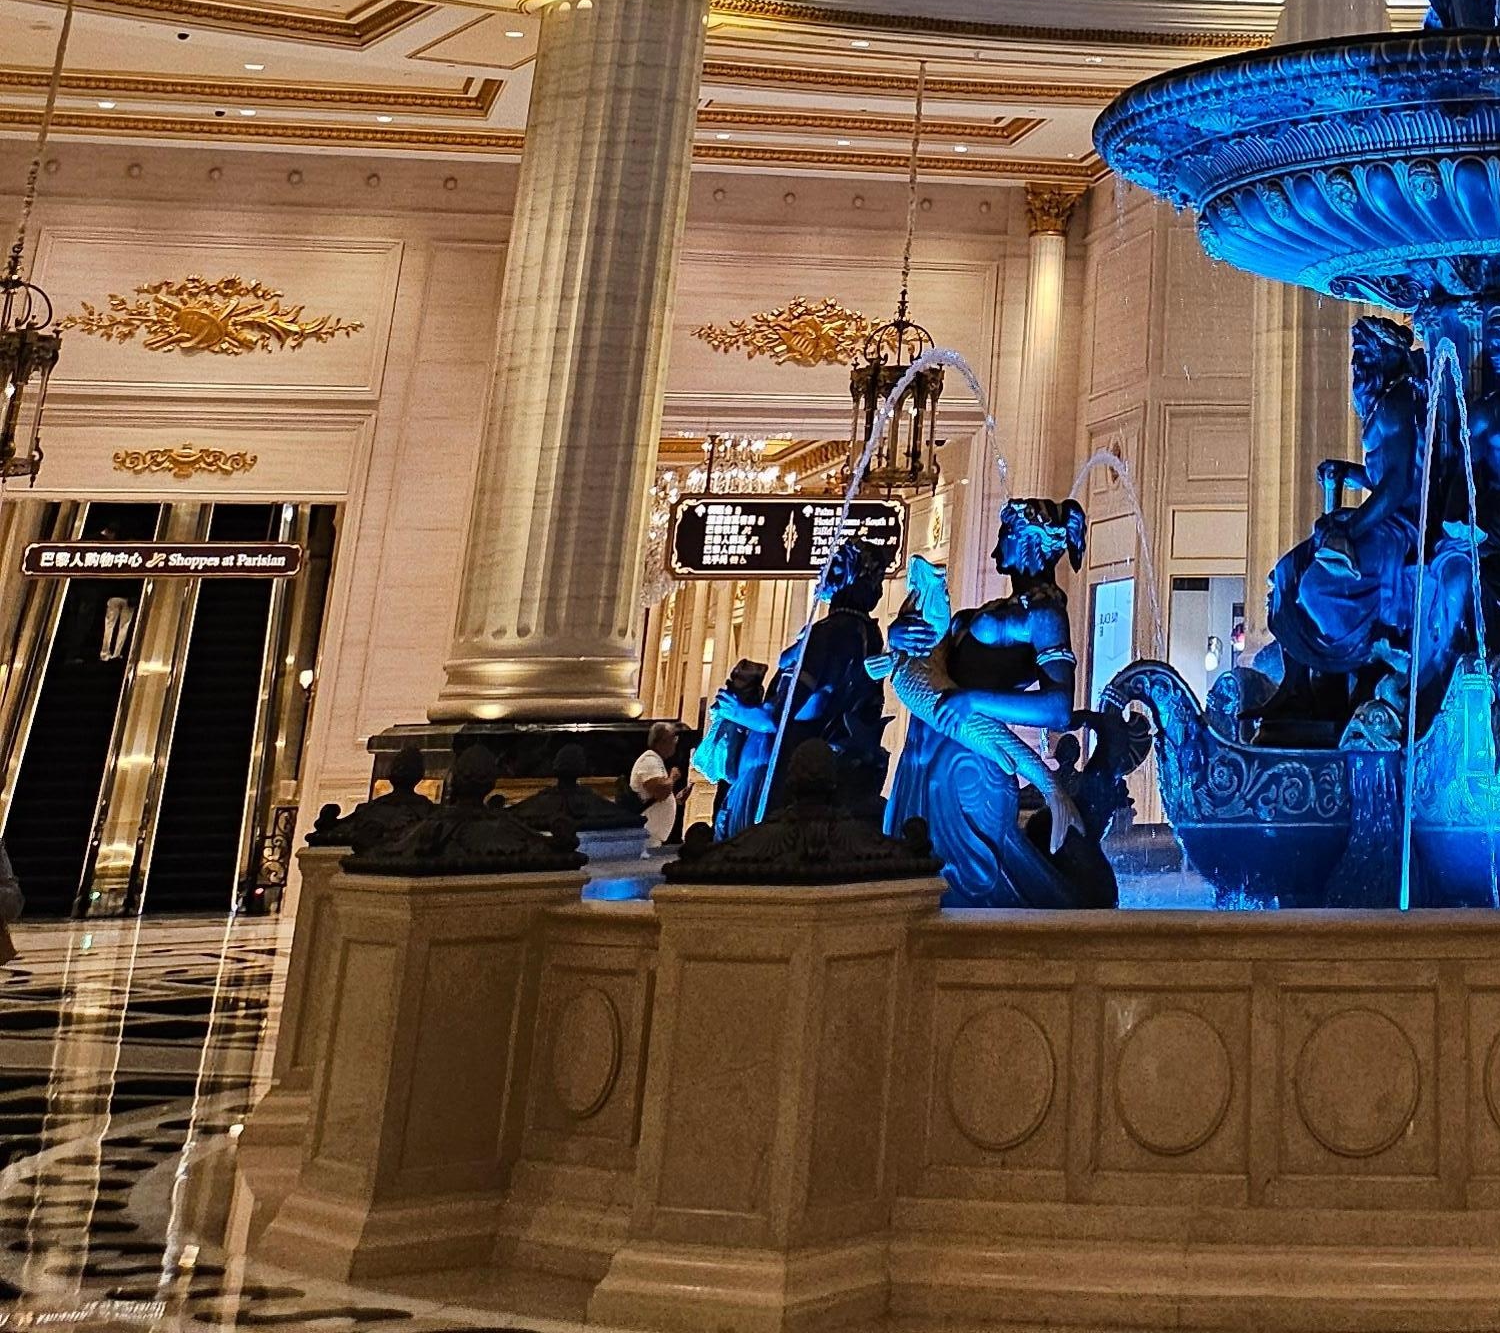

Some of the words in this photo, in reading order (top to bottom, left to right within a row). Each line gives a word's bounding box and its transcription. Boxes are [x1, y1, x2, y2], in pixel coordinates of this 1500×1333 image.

[168, 553, 219, 569] Shoppes
[220, 554, 235, 567] at
[236, 553, 286, 567] Parisian
